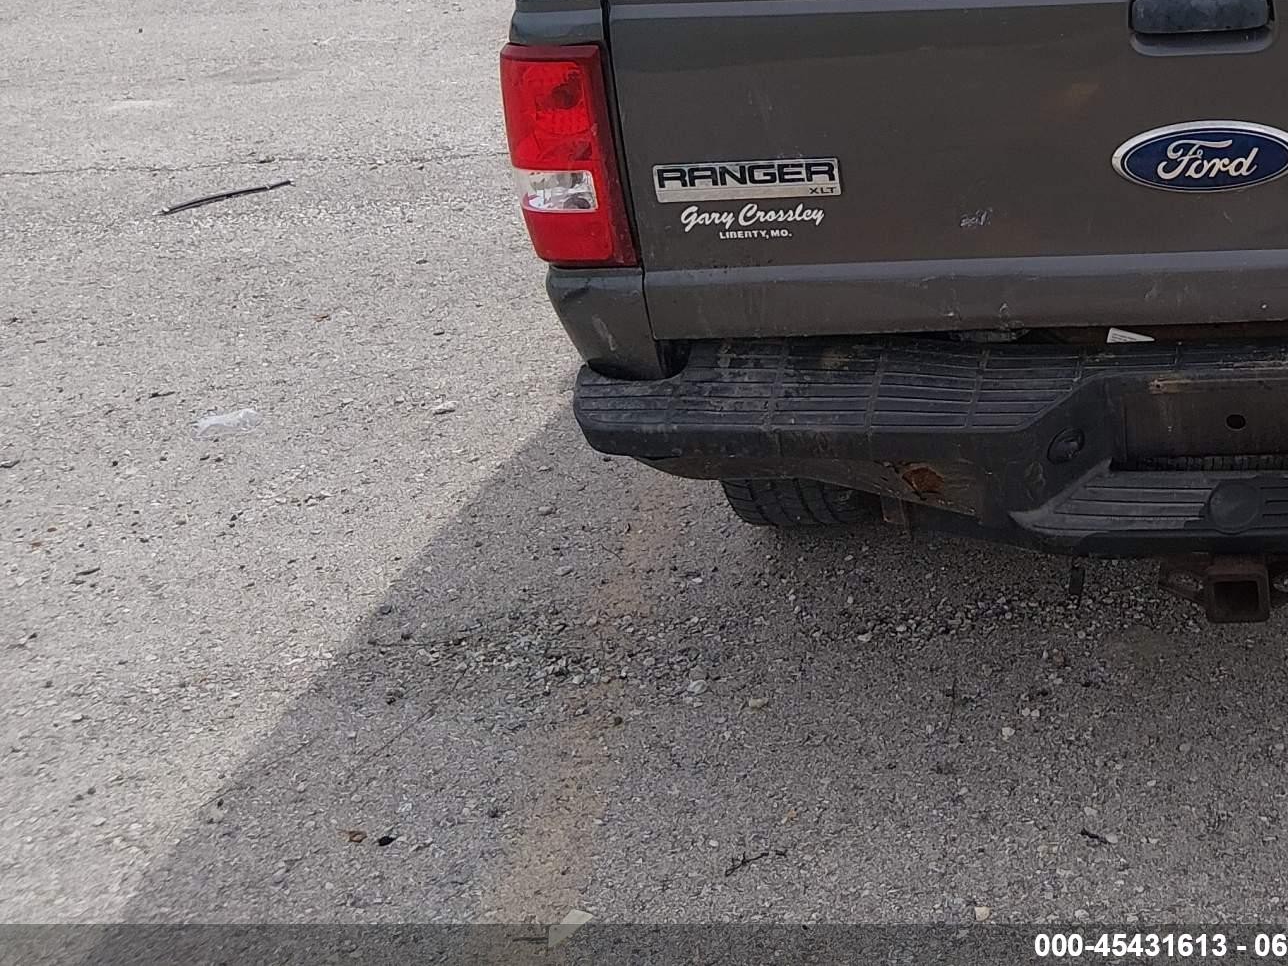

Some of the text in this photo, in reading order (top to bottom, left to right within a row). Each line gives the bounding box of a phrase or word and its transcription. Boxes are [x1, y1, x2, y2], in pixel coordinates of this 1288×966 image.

[1156, 138, 1259, 181] Ford
[656, 162, 837, 189] RANGER
[809, 186, 837, 195] XLT
[680, 203, 825, 232] Gary Crossley
[719, 228, 793, 240] LIBERTY, MO.
